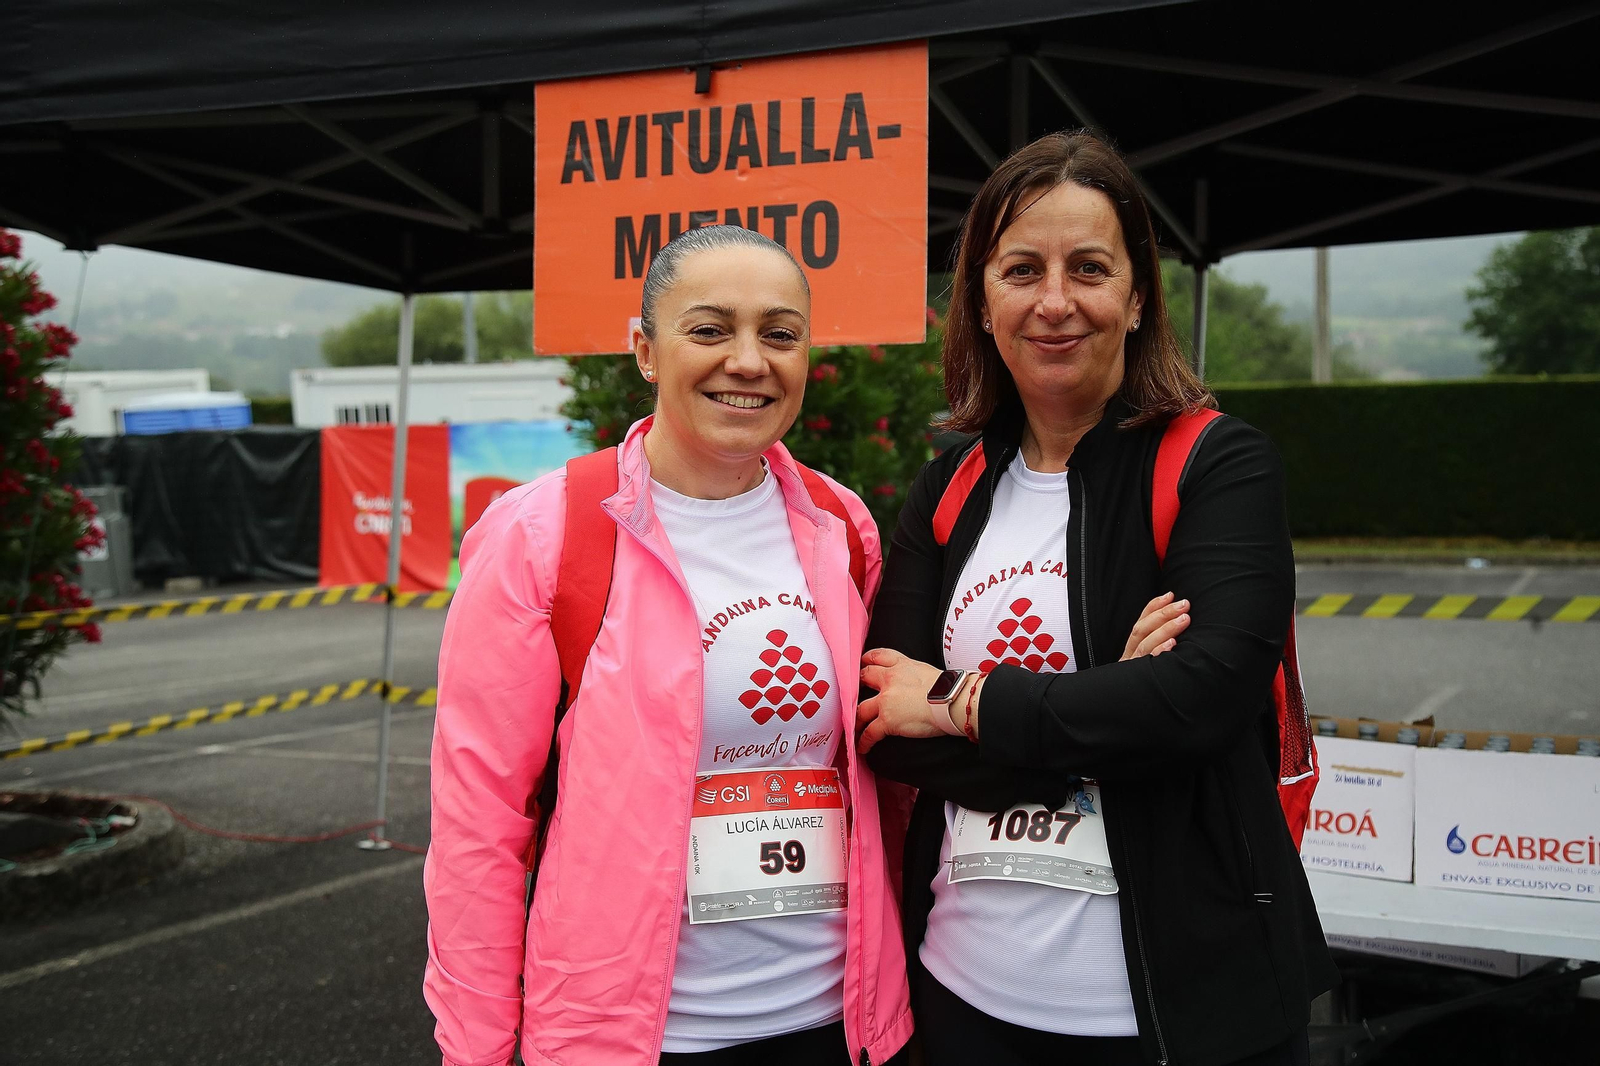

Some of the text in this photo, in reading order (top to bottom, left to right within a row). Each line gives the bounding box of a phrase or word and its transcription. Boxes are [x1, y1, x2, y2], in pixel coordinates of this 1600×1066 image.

[560, 92, 902, 184] AVITUALLA-
[614, 200, 840, 279] MTO
[954, 561, 1034, 621] ANDAINA
[1040, 559, 1068, 578] CA
[702, 596, 771, 653] ANDAINA
[713, 733, 788, 763] Facendo
[721, 785, 750, 803] GSI
[726, 816, 824, 834] LUCÍA ÁLVAREZ
[987, 808, 1082, 845] 1087
[759, 839, 806, 876] 59
[1471, 833, 1600, 865] CABREI
[1441, 873, 1595, 894] ENVASE EXCLUSIVO DE
[1538, 864, 1575, 874] NATURAL
